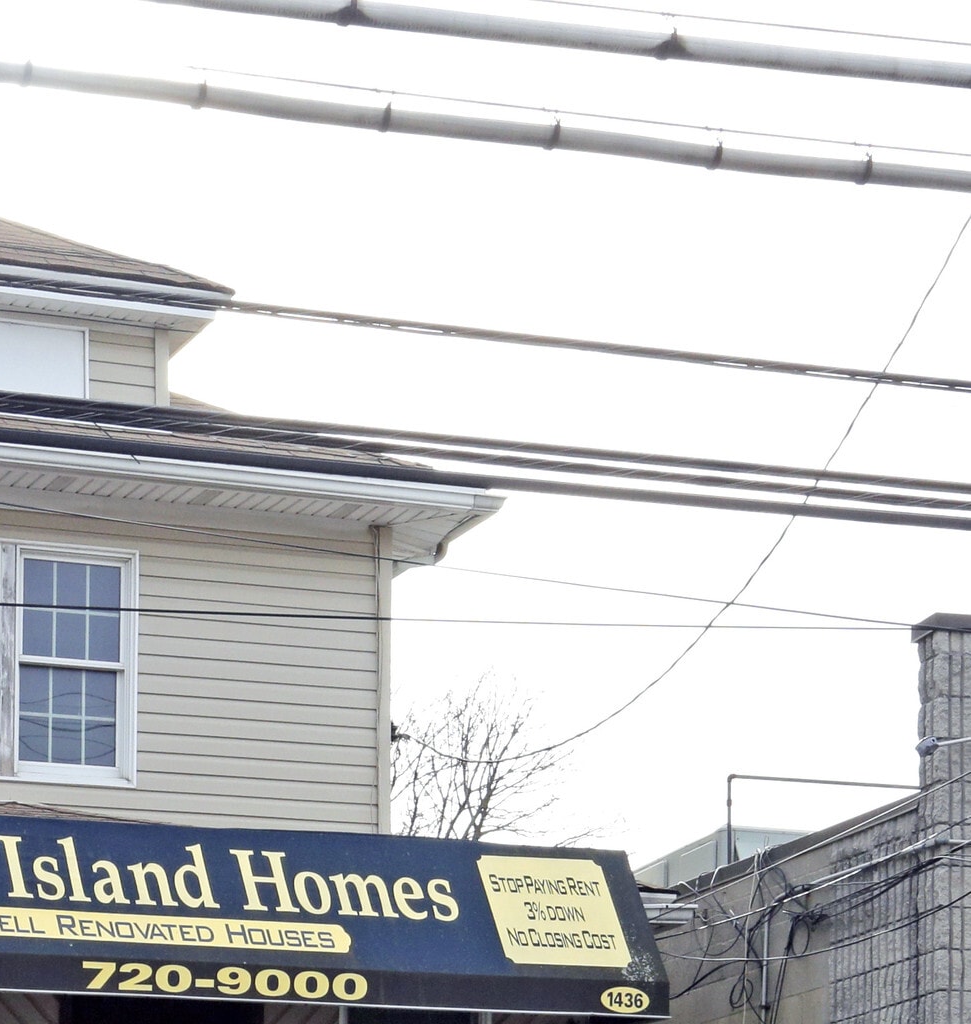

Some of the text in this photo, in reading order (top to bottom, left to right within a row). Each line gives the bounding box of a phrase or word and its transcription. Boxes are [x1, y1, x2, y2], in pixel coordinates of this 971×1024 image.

[230, 849, 460, 922] Homes
[565, 877, 601, 897] RENT
[523, 901, 546, 921] 3%
[56, 914, 214, 943] RENOVATED
[224, 923, 336, 949] HOUSES
[529, 928, 582, 949] CLOSING
[581, 930, 617, 950] COST
[82, 960, 368, 1001] 720-9000
[606, 992, 644, 1009] 1436
